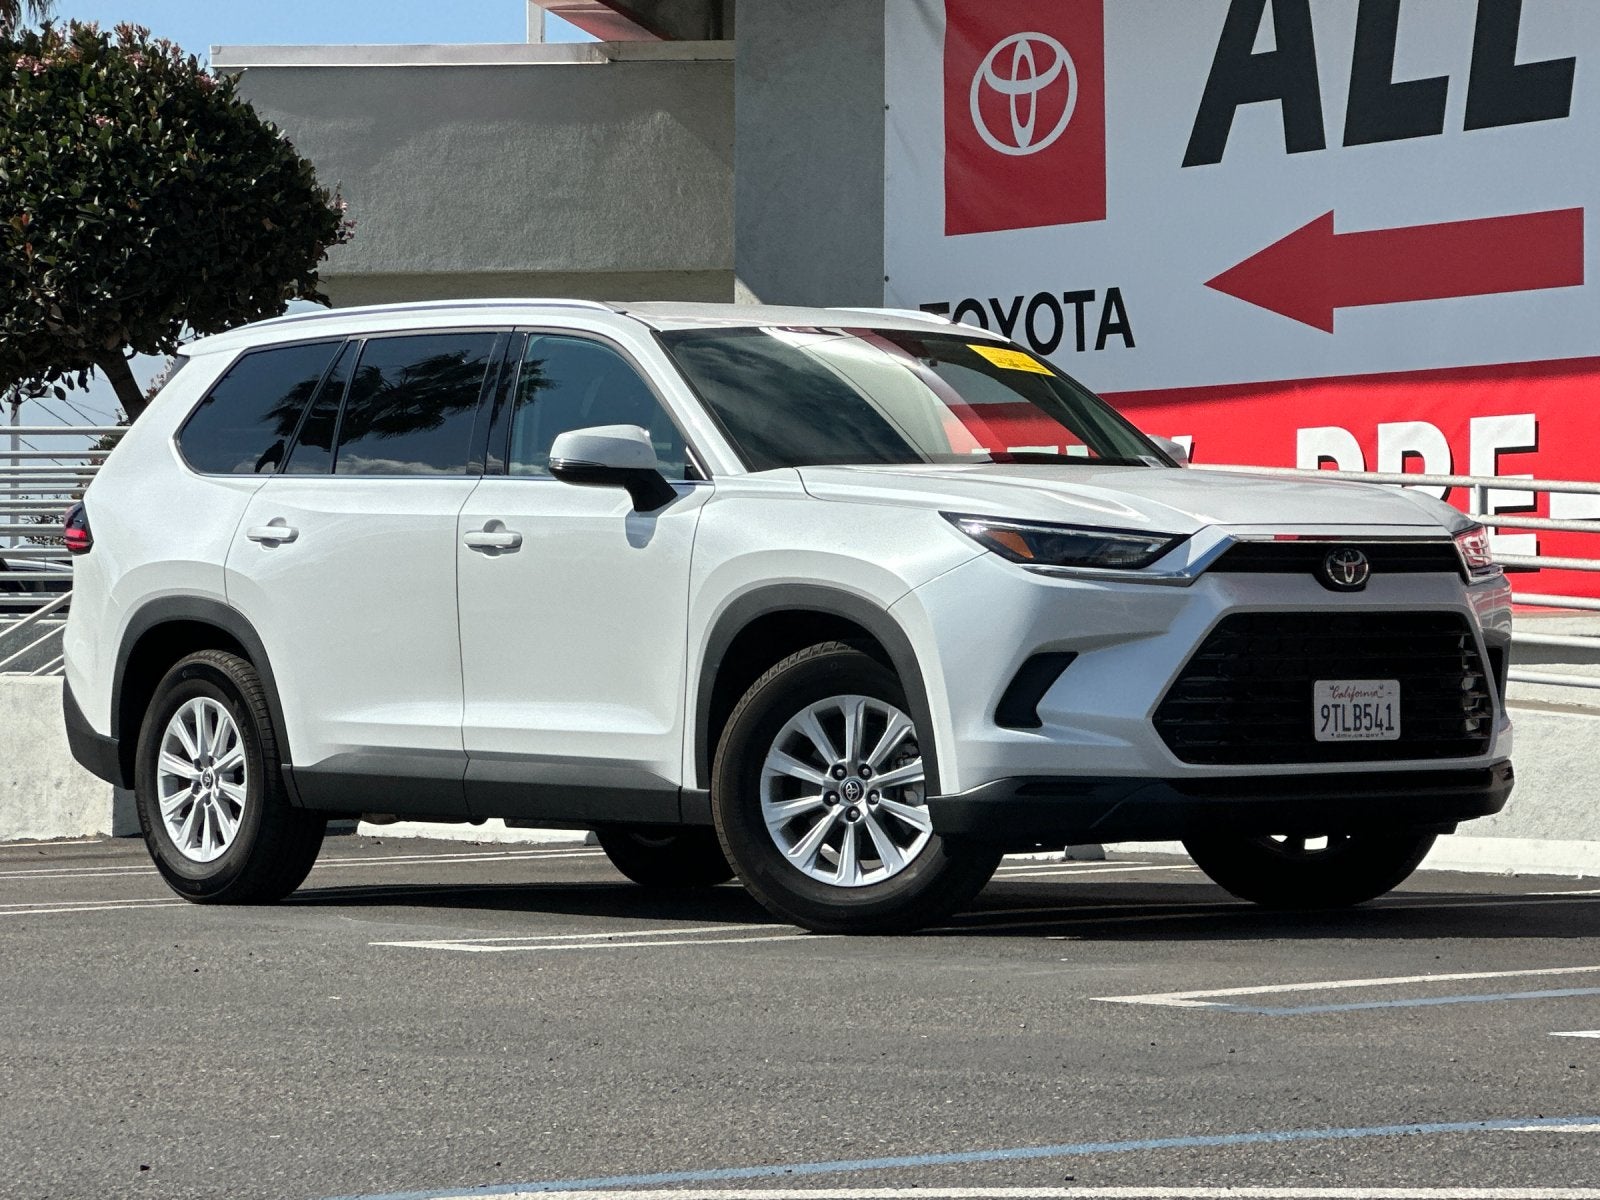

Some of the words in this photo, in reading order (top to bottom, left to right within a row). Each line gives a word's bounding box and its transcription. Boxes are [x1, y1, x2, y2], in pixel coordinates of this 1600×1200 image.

[1181, 0, 1576, 168] ALL
[1331, 685, 1380, 703] California
[1320, 703, 1395, 732] 9TLB541
